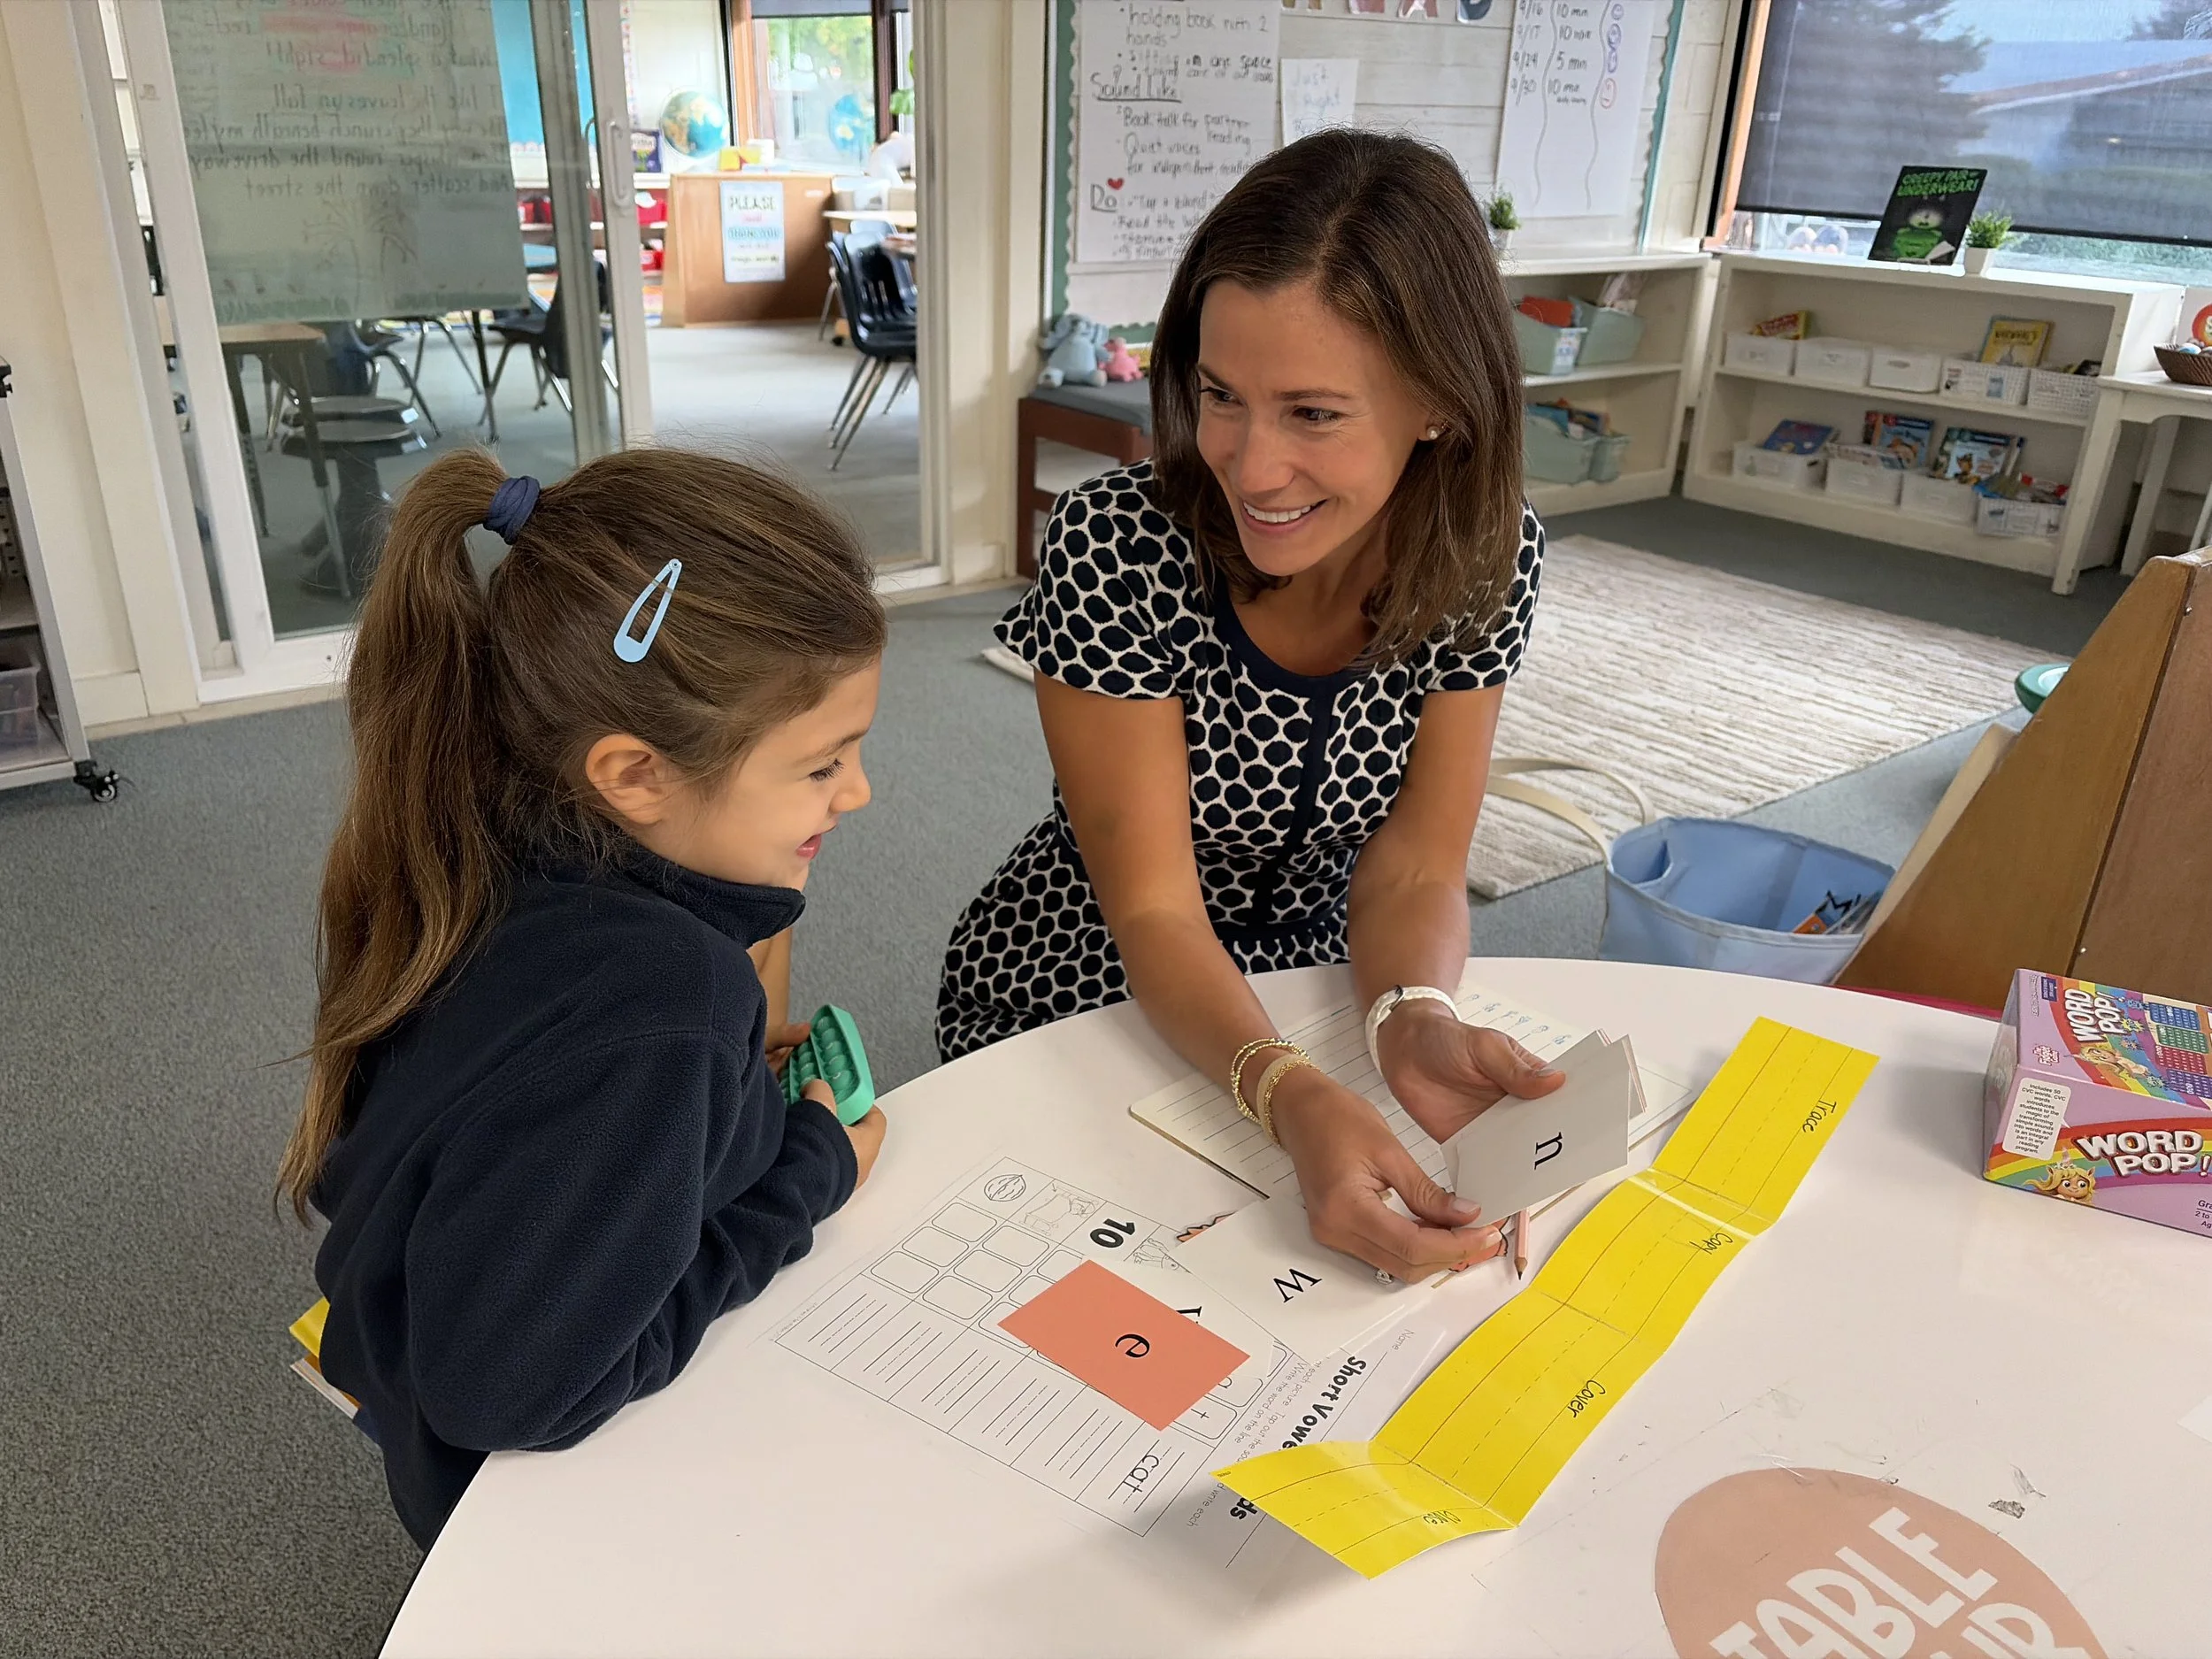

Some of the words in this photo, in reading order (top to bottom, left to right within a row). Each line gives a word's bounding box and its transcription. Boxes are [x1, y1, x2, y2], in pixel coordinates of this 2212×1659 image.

[1557, 4, 1569, 18] 10
[1560, 25, 1572, 40] 10
[1557, 50, 1564, 70] 5
[2065, 988, 2107, 1041] WORD
[2094, 991, 2128, 1034] POP!
[2030, 1084, 2053, 1093] Includes
[2019, 1103, 2042, 1112] students
[2026, 1100, 2055, 1110] introduces
[1802, 1100, 1837, 1133] Trace
[2019, 1114, 2054, 1126] transforming
[2018, 1140, 2039, 1149] reading
[2029, 1132, 2048, 1141] integral
[2076, 1130, 2203, 1160] WORD
[1533, 1132, 1563, 1170] n
[2113, 1153, 2211, 1176] POP!
[2198, 1200, 2212, 1210] Gra
[1090, 1218, 1135, 1248] 10
[1689, 1232, 1733, 1255] Copy
[1115, 1333, 1150, 1358] e
[1391, 1328, 1415, 1351] Name
[1286, 1362, 1308, 1381] Write
[1302, 1368, 1316, 1385] each
[1321, 1356, 1367, 1402] Short
[1275, 1381, 1288, 1393] the
[1282, 1382, 1302, 1407] picture
[1262, 1393, 1278, 1410] word
[1567, 1379, 1606, 1417] Cover
[1256, 1409, 1264, 1419] on
[1268, 1411, 1286, 1425] Tap
[1244, 1419, 1258, 1432] the
[1259, 1425, 1271, 1438] out
[1282, 1403, 1334, 1451] Vowe
[1248, 1438, 1262, 1449] the
[1122, 1455, 1160, 1494] cat
[1202, 1489, 1219, 1507] write
[1187, 1508, 1204, 1527] each
